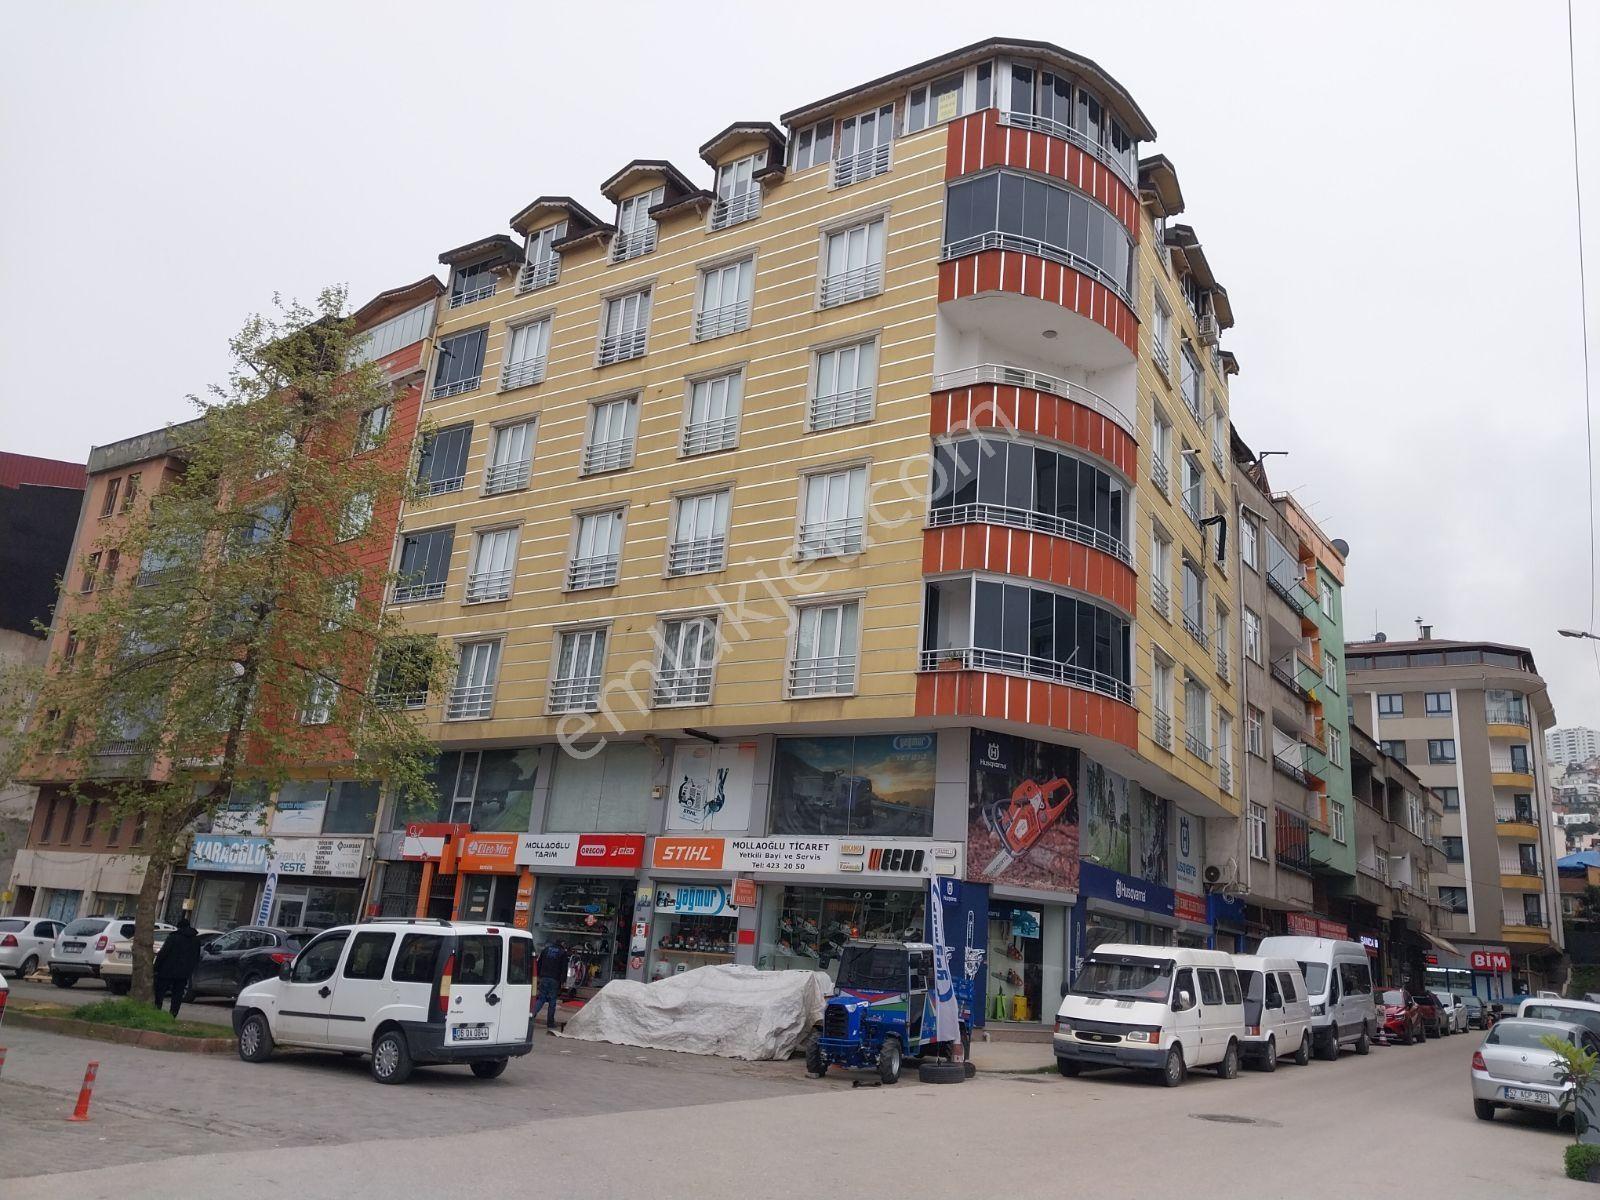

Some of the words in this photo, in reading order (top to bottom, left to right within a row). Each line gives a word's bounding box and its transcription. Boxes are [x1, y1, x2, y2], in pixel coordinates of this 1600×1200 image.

[980, 759, 1007, 769] Husqvarna
[525, 841, 570, 849] MOLLAOĞLU
[732, 841, 785, 850] MOLLAOĞLU
[789, 841, 830, 851] TİCARET
[662, 846, 712, 861] STIHL
[765, 853, 781, 861] Bayi
[796, 853, 821, 861] Servis
[675, 886, 717, 911] yağmur
[1121, 883, 1146, 902] Husqvarna
[1474, 952, 1507, 968] BİM
